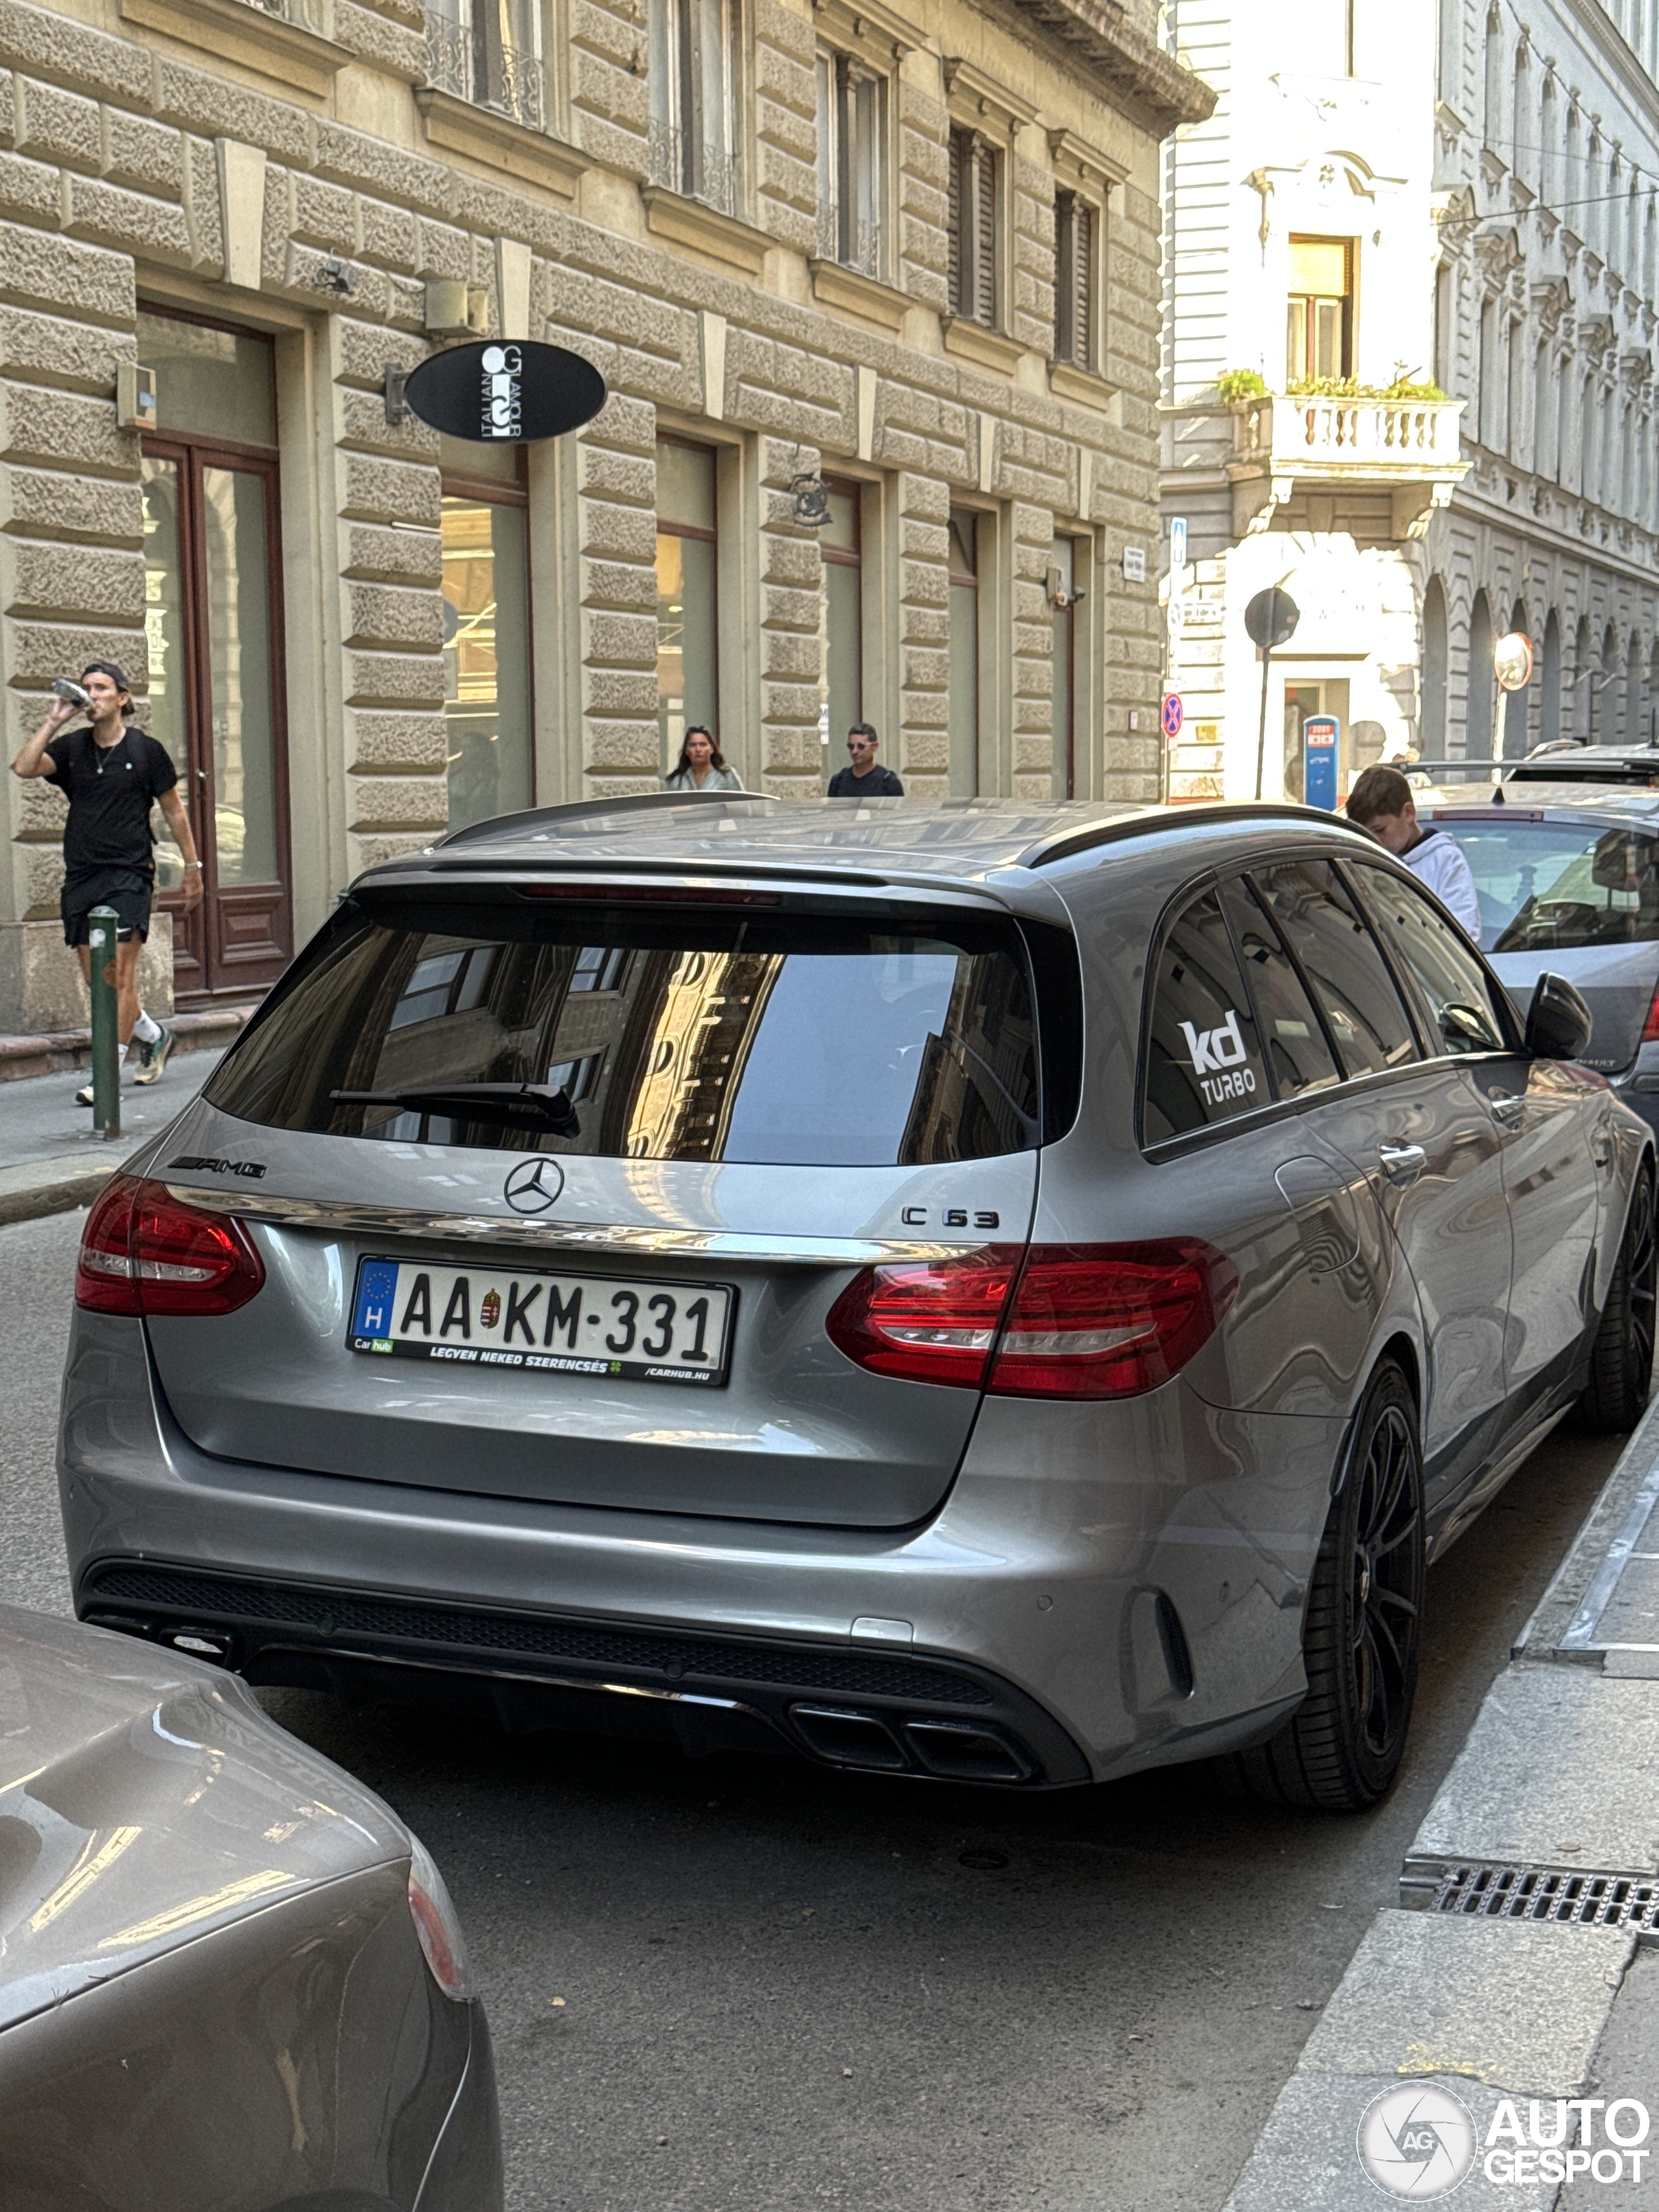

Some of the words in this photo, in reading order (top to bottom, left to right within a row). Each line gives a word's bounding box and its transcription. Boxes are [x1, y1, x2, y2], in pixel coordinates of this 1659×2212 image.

[481, 373, 493, 437] ITALIAN
[502, 345, 522, 437] GLAMOUR
[1177, 1009, 1247, 1075] kd
[1200, 1068, 1256, 1106] TURBO
[196, 1158, 268, 1179] AMG
[901, 1206, 927, 1225] C
[942, 1209, 1000, 1229] 63
[365, 1306, 383, 1329] H
[504, 1281, 709, 1361] KM-331
[430, 1346, 478, 1361] LEGYEN
[480, 1352, 523, 1365] NEKED
[525, 1356, 609, 1374] SZERENCSÉS
[645, 1368, 710, 1381] /CARHUB.HU
